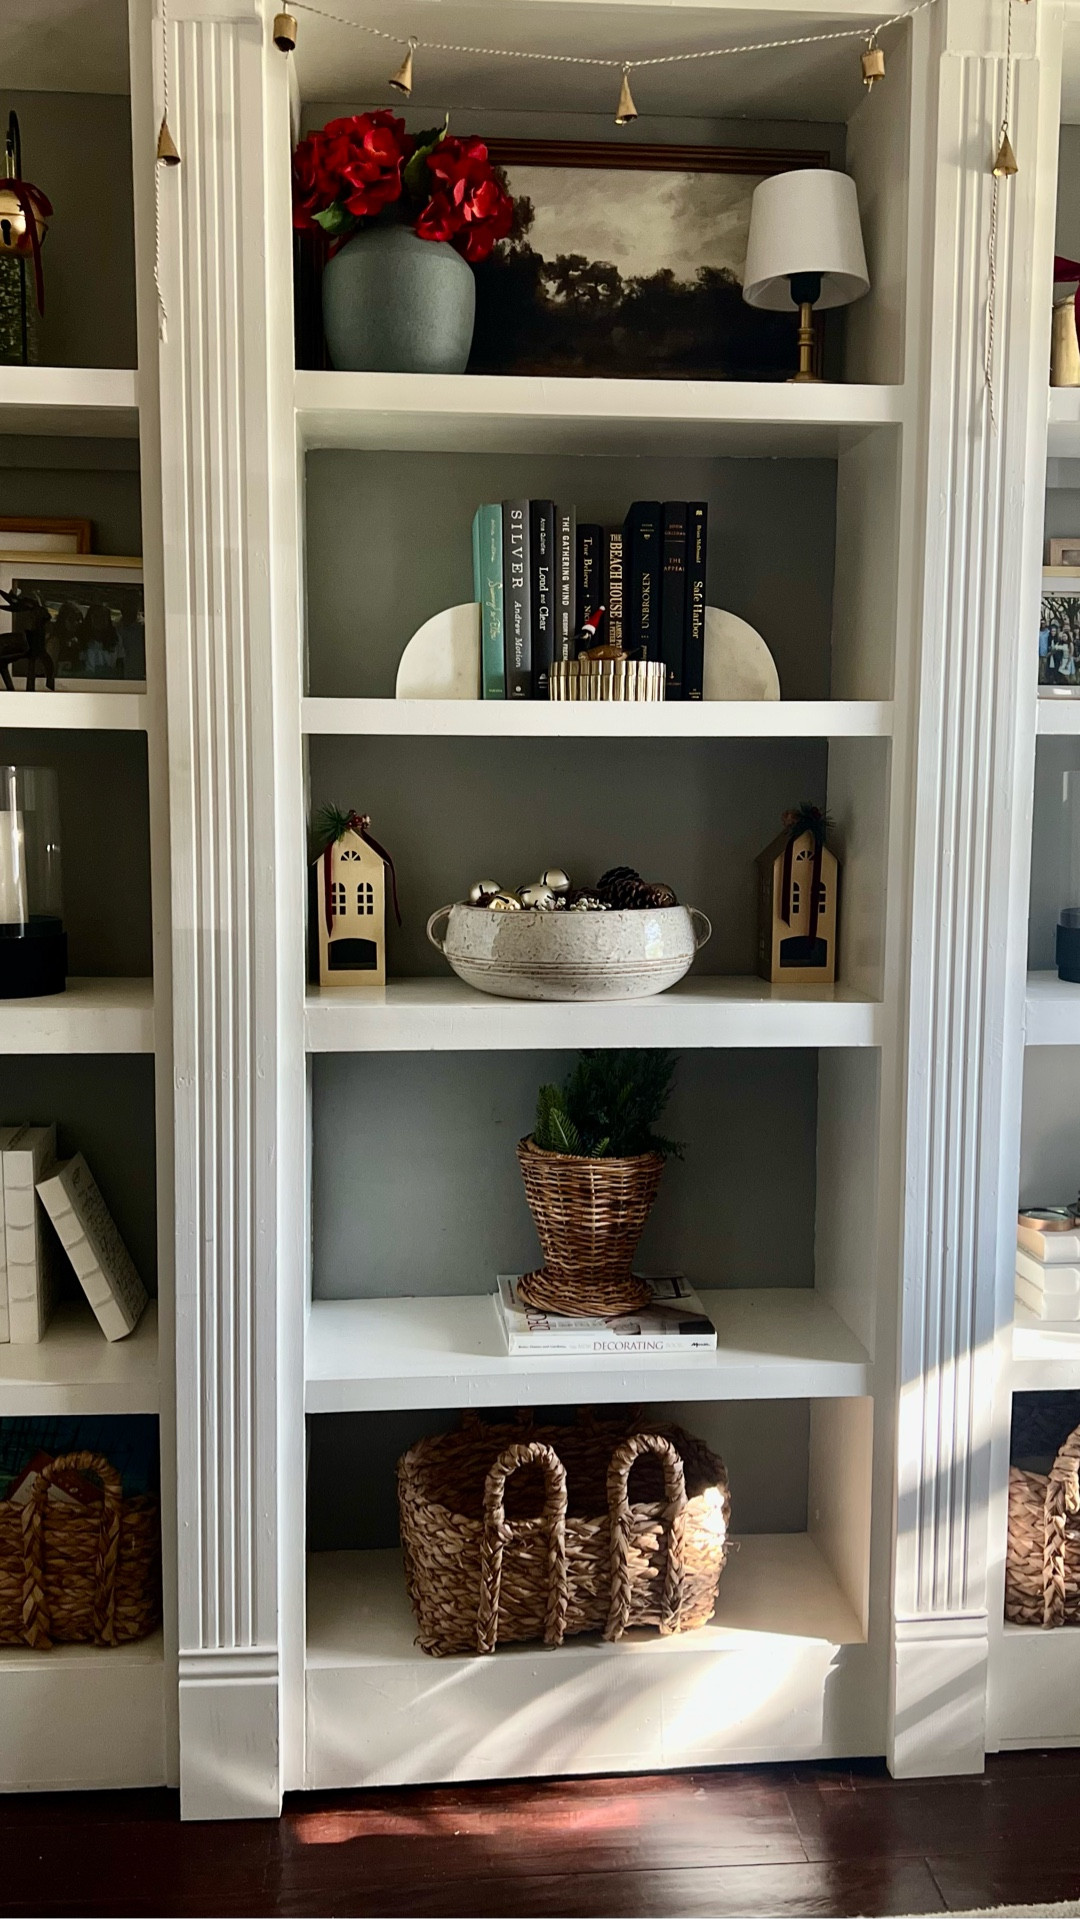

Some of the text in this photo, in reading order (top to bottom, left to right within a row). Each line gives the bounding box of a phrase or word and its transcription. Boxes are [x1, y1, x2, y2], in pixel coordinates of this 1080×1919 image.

[511, 510, 523, 589] SILVER
[538, 566, 549, 591] Loud
[562, 516, 570, 606] THE GATHERING WIND
[583, 537, 593, 588] True Believer
[609, 533, 623, 618] THE BEACH HOUSE
[539, 606, 549, 630] Clear
[641, 572, 651, 629] UNBROKEN
[692, 580, 703, 639] Safe Harbor
[514, 600, 522, 668] Andrew Motion
[593, 1341, 663, 1351] DECORATING
